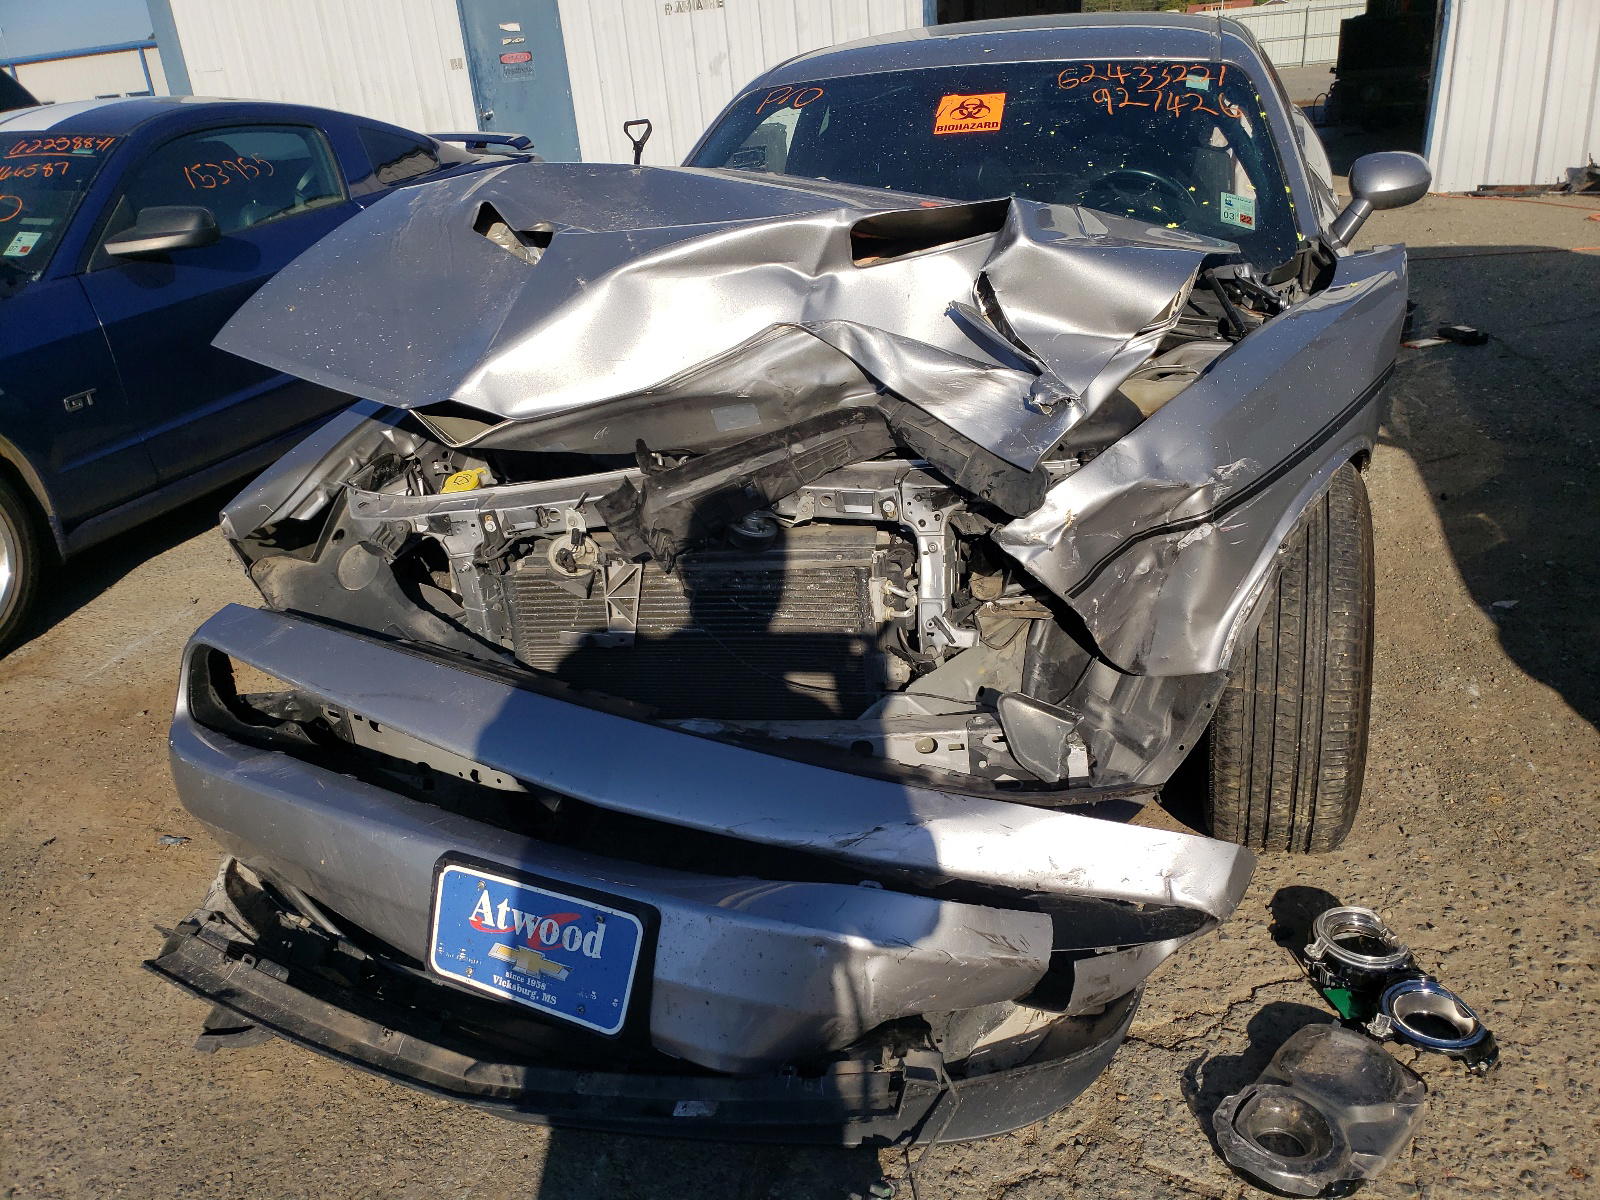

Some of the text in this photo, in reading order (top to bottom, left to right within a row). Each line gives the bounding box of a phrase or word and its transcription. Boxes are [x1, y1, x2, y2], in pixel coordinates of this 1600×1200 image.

[1057, 64, 1226, 90] 62433221
[1092, 88, 1243, 118] 927426
[936, 121, 999, 132] BIOHAZARD
[1223, 211, 1235, 220] 03
[63, 388, 96, 412] GT
[469, 889, 606, 959] Atwood
[505, 970, 525, 984] since
[542, 993, 557, 1005] MS
